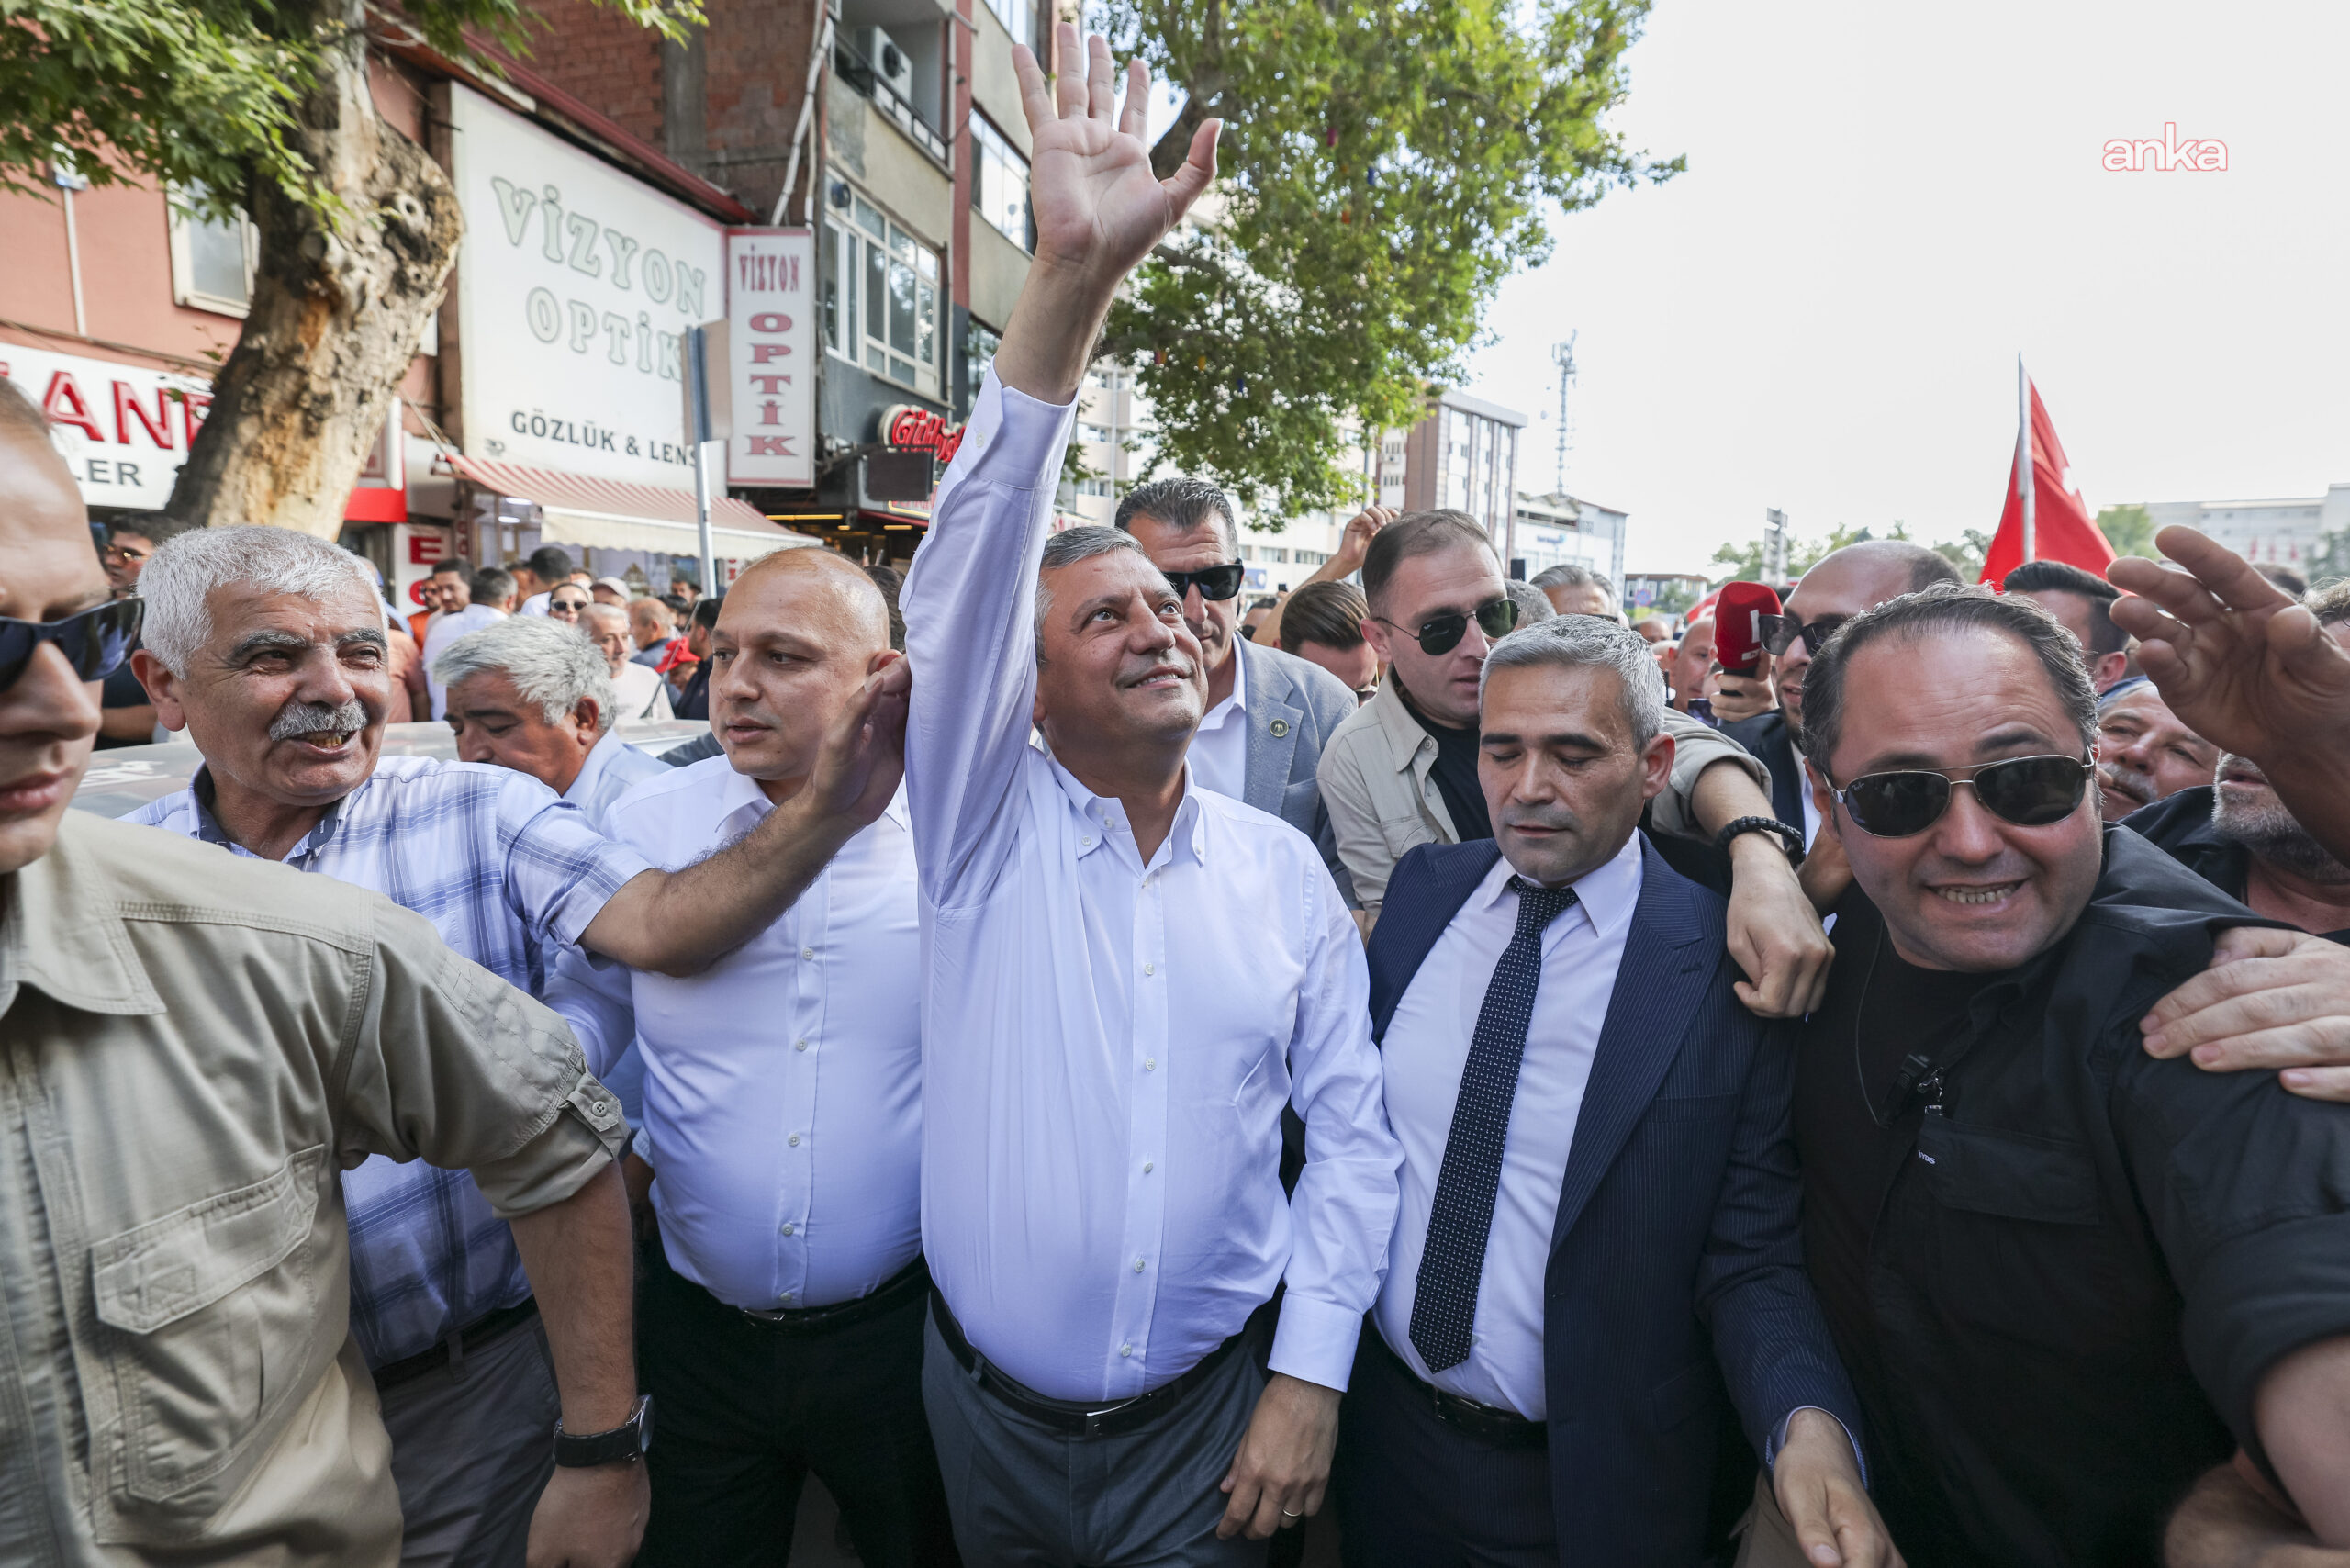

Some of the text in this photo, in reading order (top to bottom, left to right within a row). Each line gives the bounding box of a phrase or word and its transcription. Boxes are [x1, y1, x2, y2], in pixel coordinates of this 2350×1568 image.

[490, 176, 706, 319] VİZYON
[739, 243, 800, 292] VİZYON
[745, 311, 799, 456] OPTİK
[511, 408, 616, 453] GÖZLÜK
[625, 435, 641, 456] &
[76, 458, 142, 487] ER
